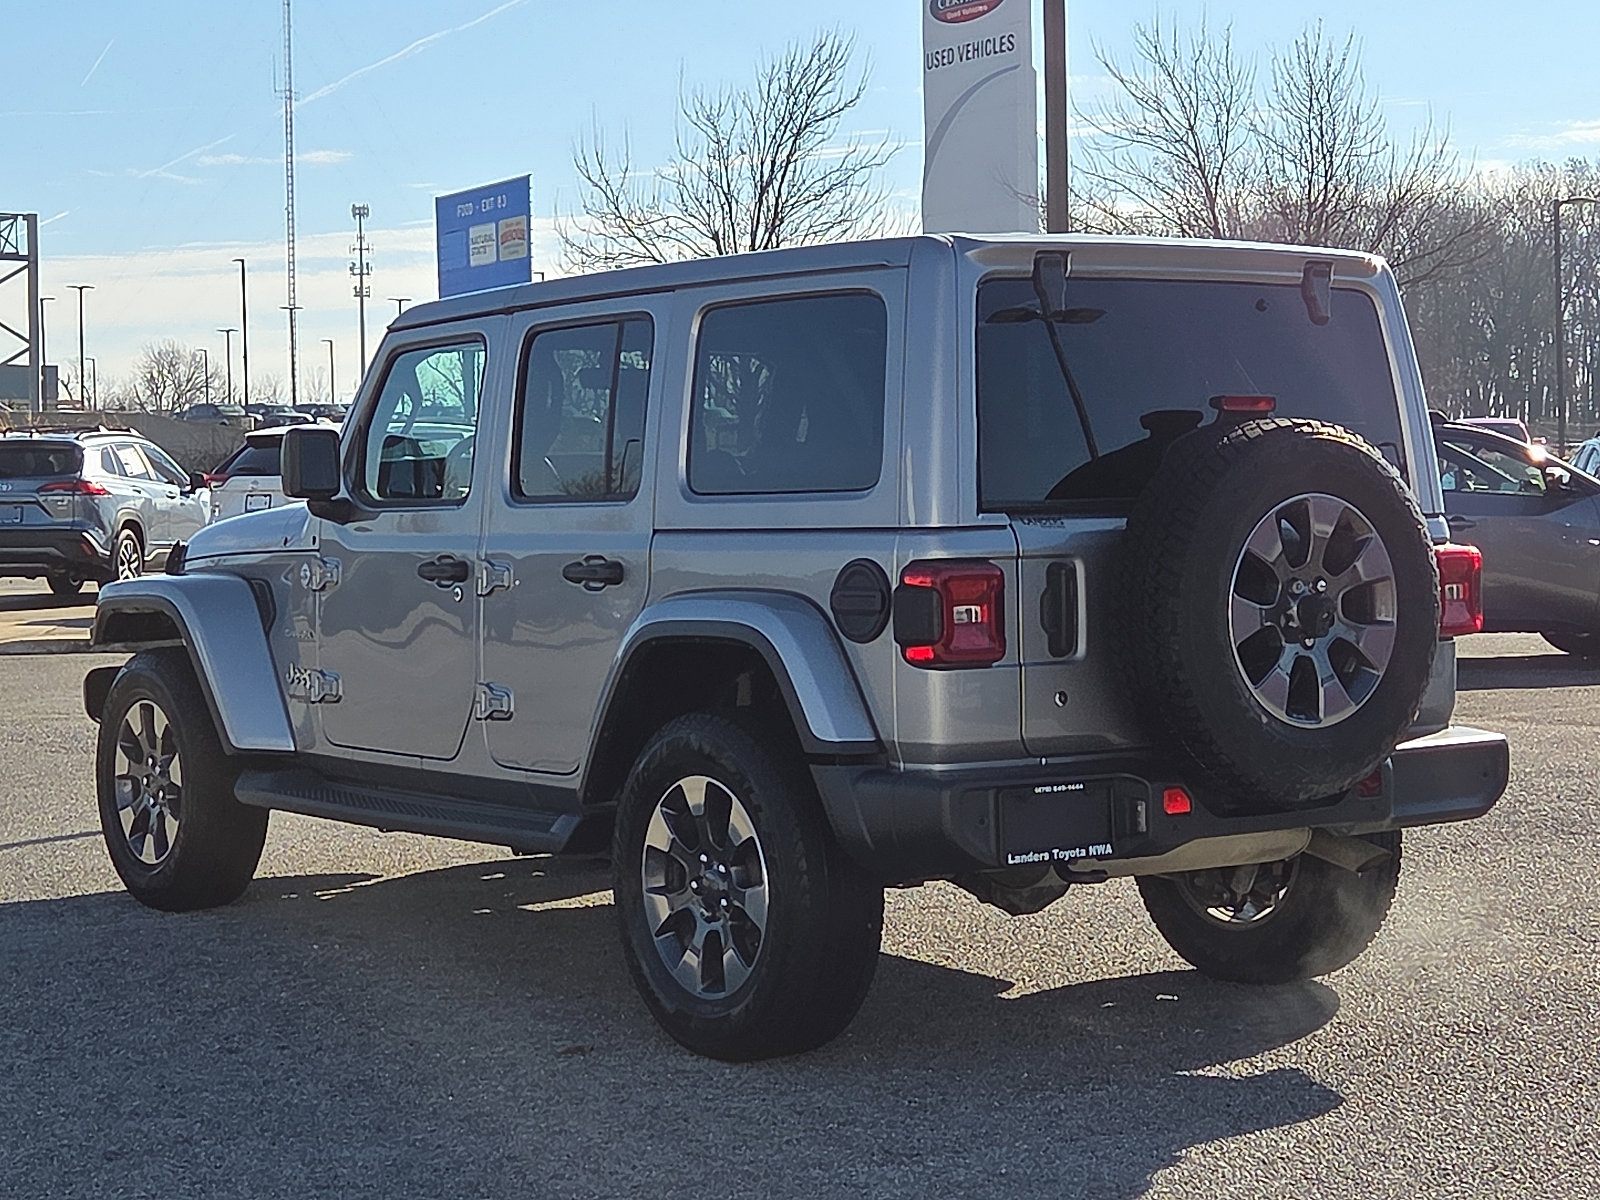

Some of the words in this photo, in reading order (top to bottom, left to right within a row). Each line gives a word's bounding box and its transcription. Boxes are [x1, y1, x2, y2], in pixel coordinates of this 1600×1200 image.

[926, 47, 955, 70] USED
[957, 33, 1015, 62] VEHICLES
[457, 202, 473, 218] FOOD
[481, 197, 495, 212] EXIT
[1007, 850, 1050, 865] Landers
[1052, 848, 1086, 861] Toyota
[1088, 843, 1113, 857] NWA
